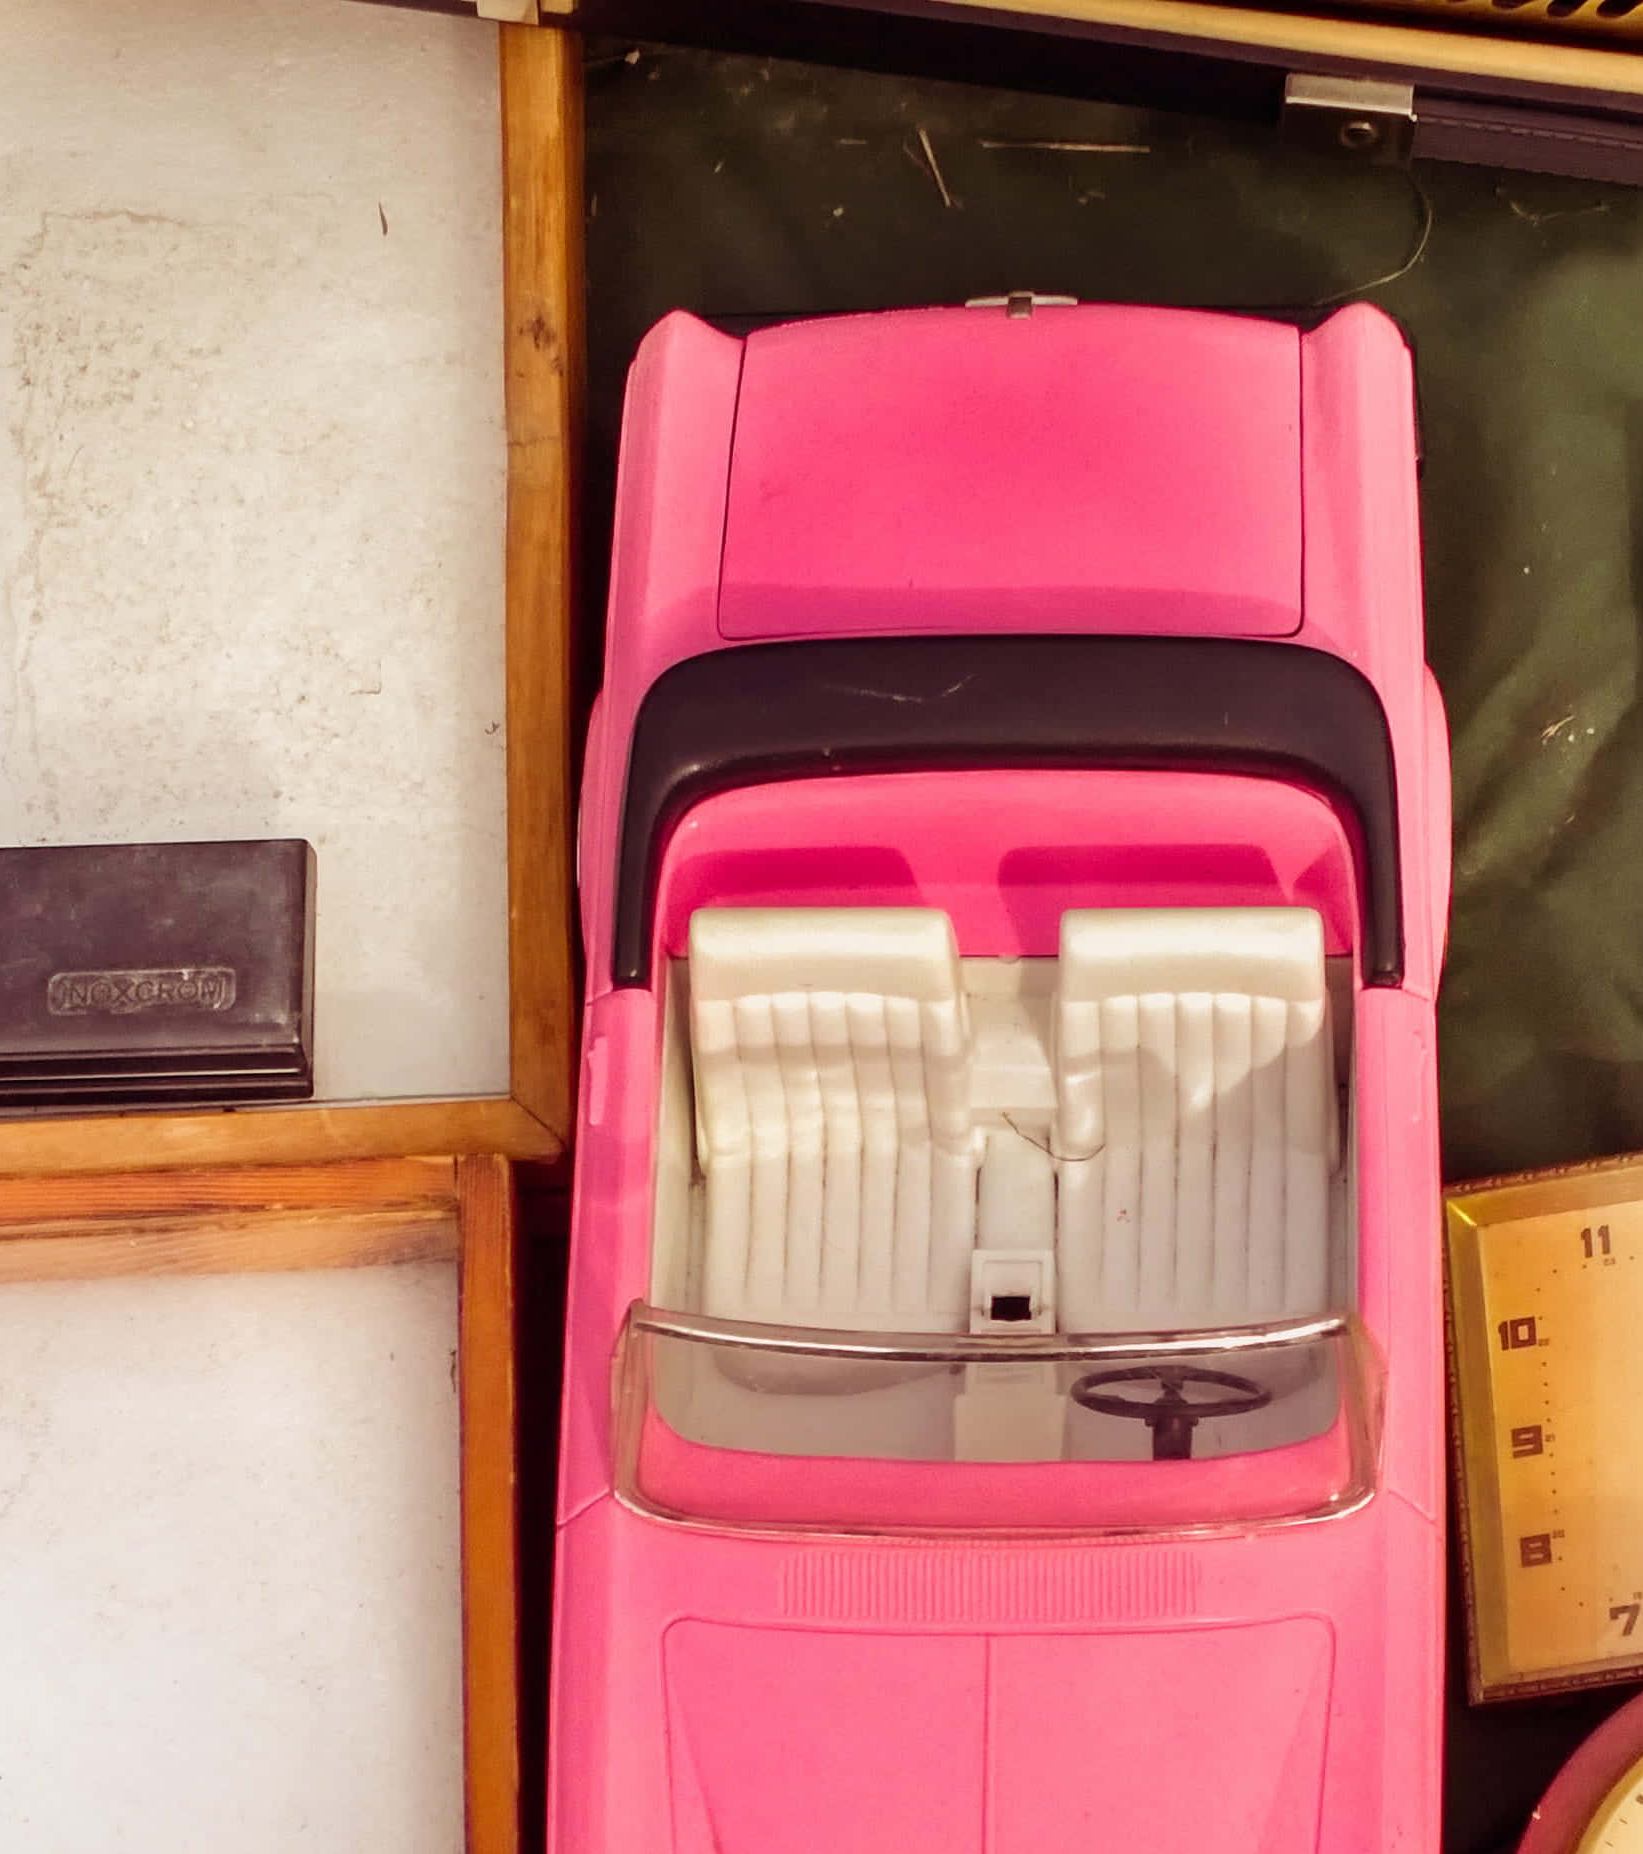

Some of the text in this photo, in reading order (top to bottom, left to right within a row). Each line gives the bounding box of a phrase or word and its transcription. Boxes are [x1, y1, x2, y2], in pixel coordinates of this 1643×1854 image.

[1580, 1225, 1612, 1258] 11
[1498, 1316, 1536, 1350] 10
[1511, 1425, 1544, 1459] 9
[1520, 1533, 1552, 1568] 8
[1610, 1604, 1641, 1636] 7
